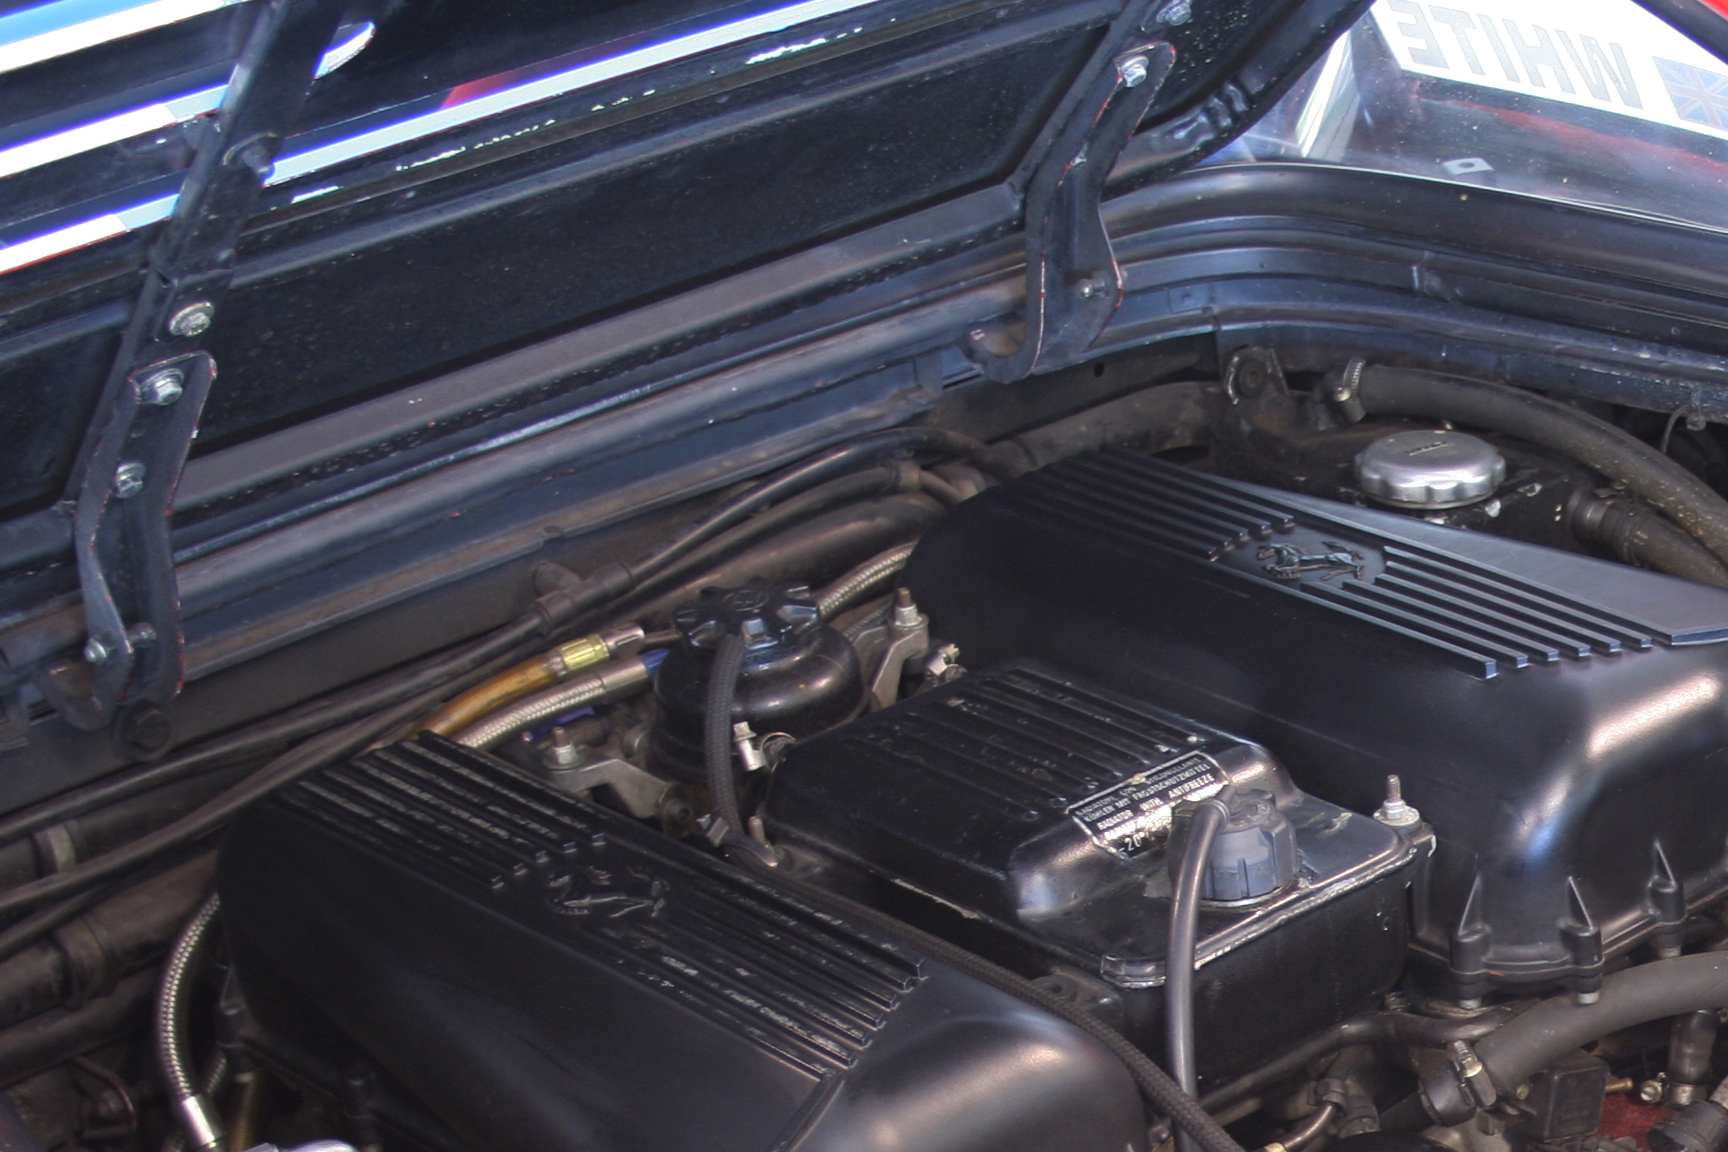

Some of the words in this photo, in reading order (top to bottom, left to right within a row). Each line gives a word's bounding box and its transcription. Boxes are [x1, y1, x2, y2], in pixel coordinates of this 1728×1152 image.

[1115, 798, 1132, 812] MIT
[1138, 796, 1164, 811] WITH
[1167, 773, 1216, 799] ANTIFREEZE
